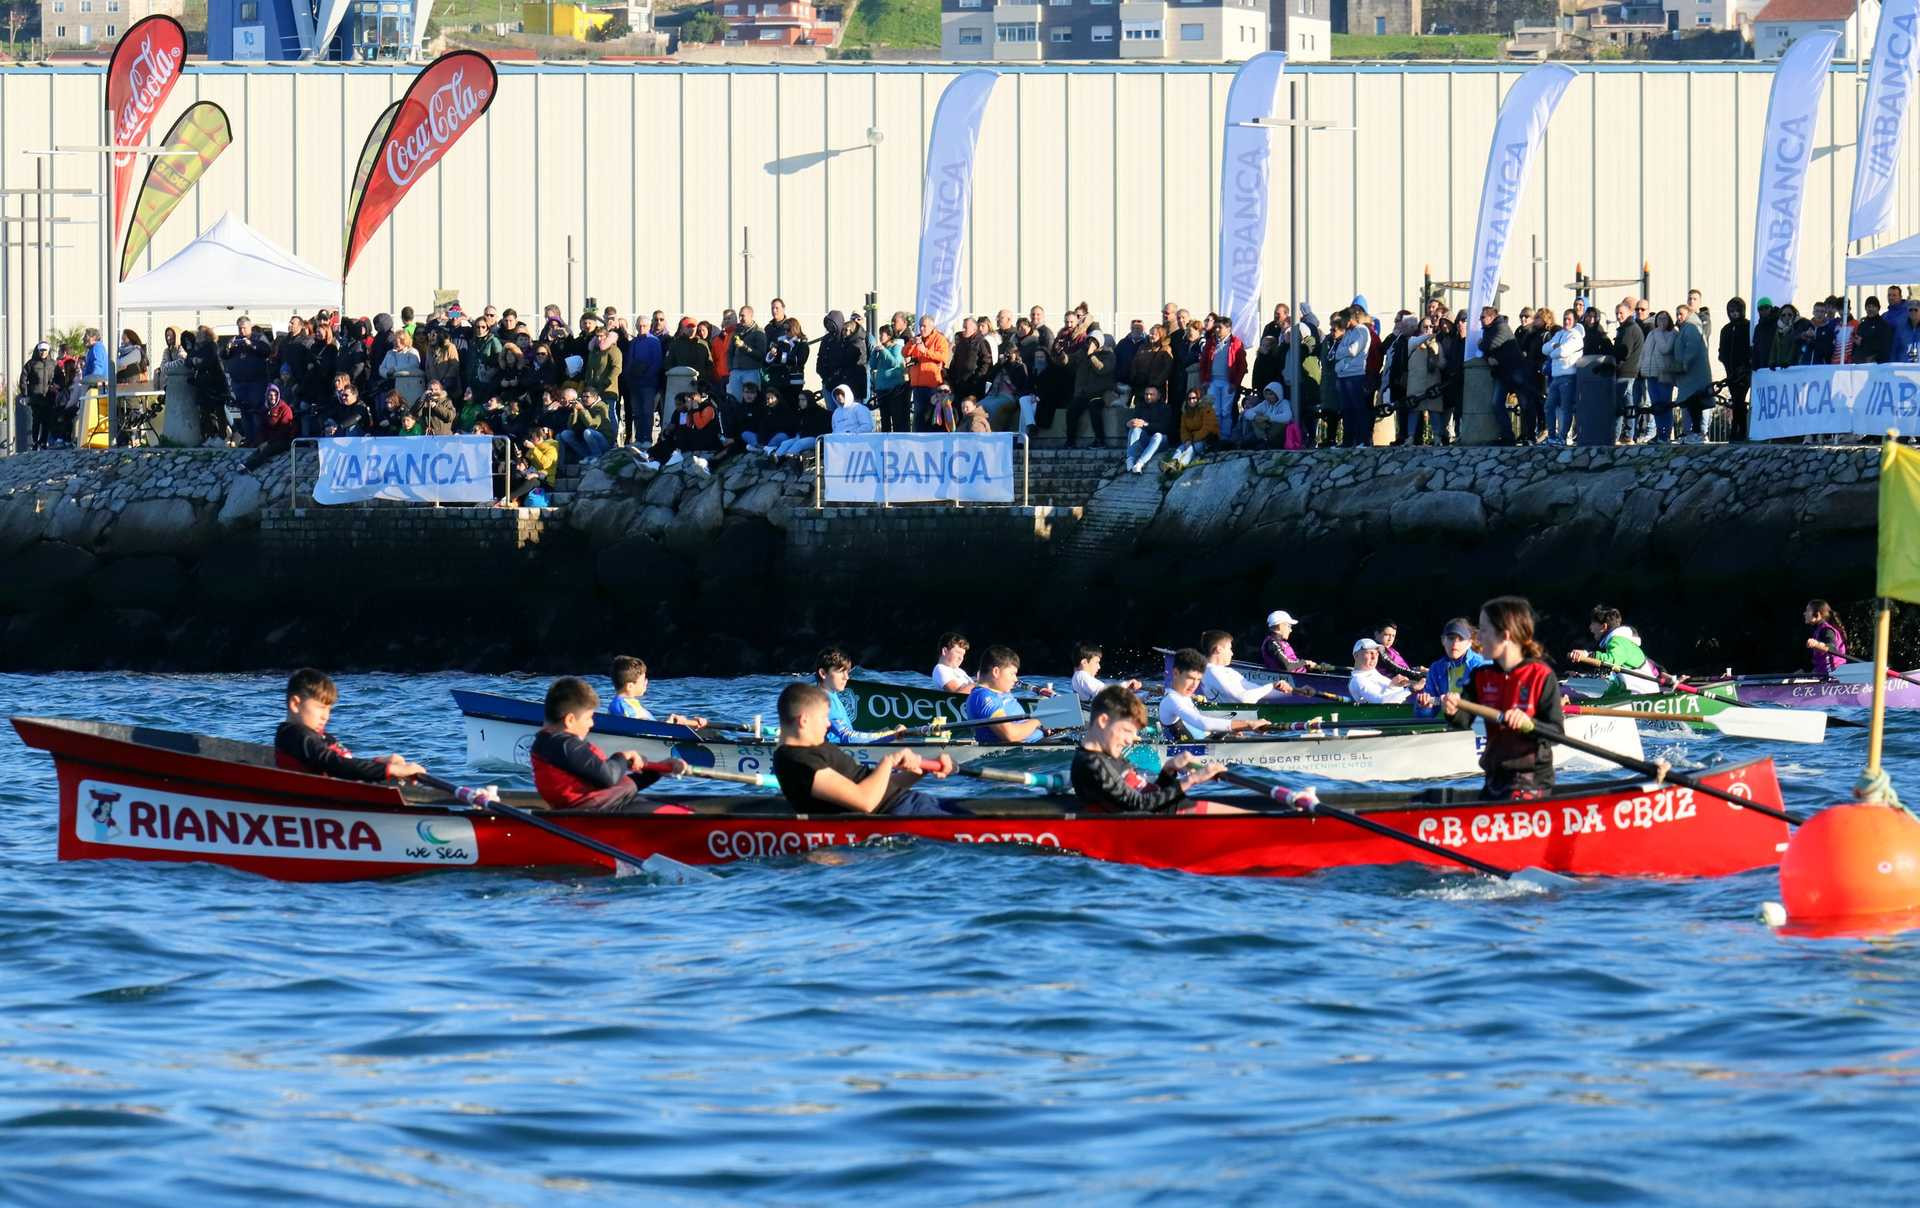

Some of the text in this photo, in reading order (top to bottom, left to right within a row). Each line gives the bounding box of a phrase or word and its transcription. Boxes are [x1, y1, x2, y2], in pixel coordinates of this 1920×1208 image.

[1821, 684, 1860, 695] VIRXE
[129, 800, 382, 852] RIANXEIRA
[1471, 810, 1552, 843] CABO
[1562, 804, 1606, 835] DA
[1613, 786, 1697, 830] CRUZ
